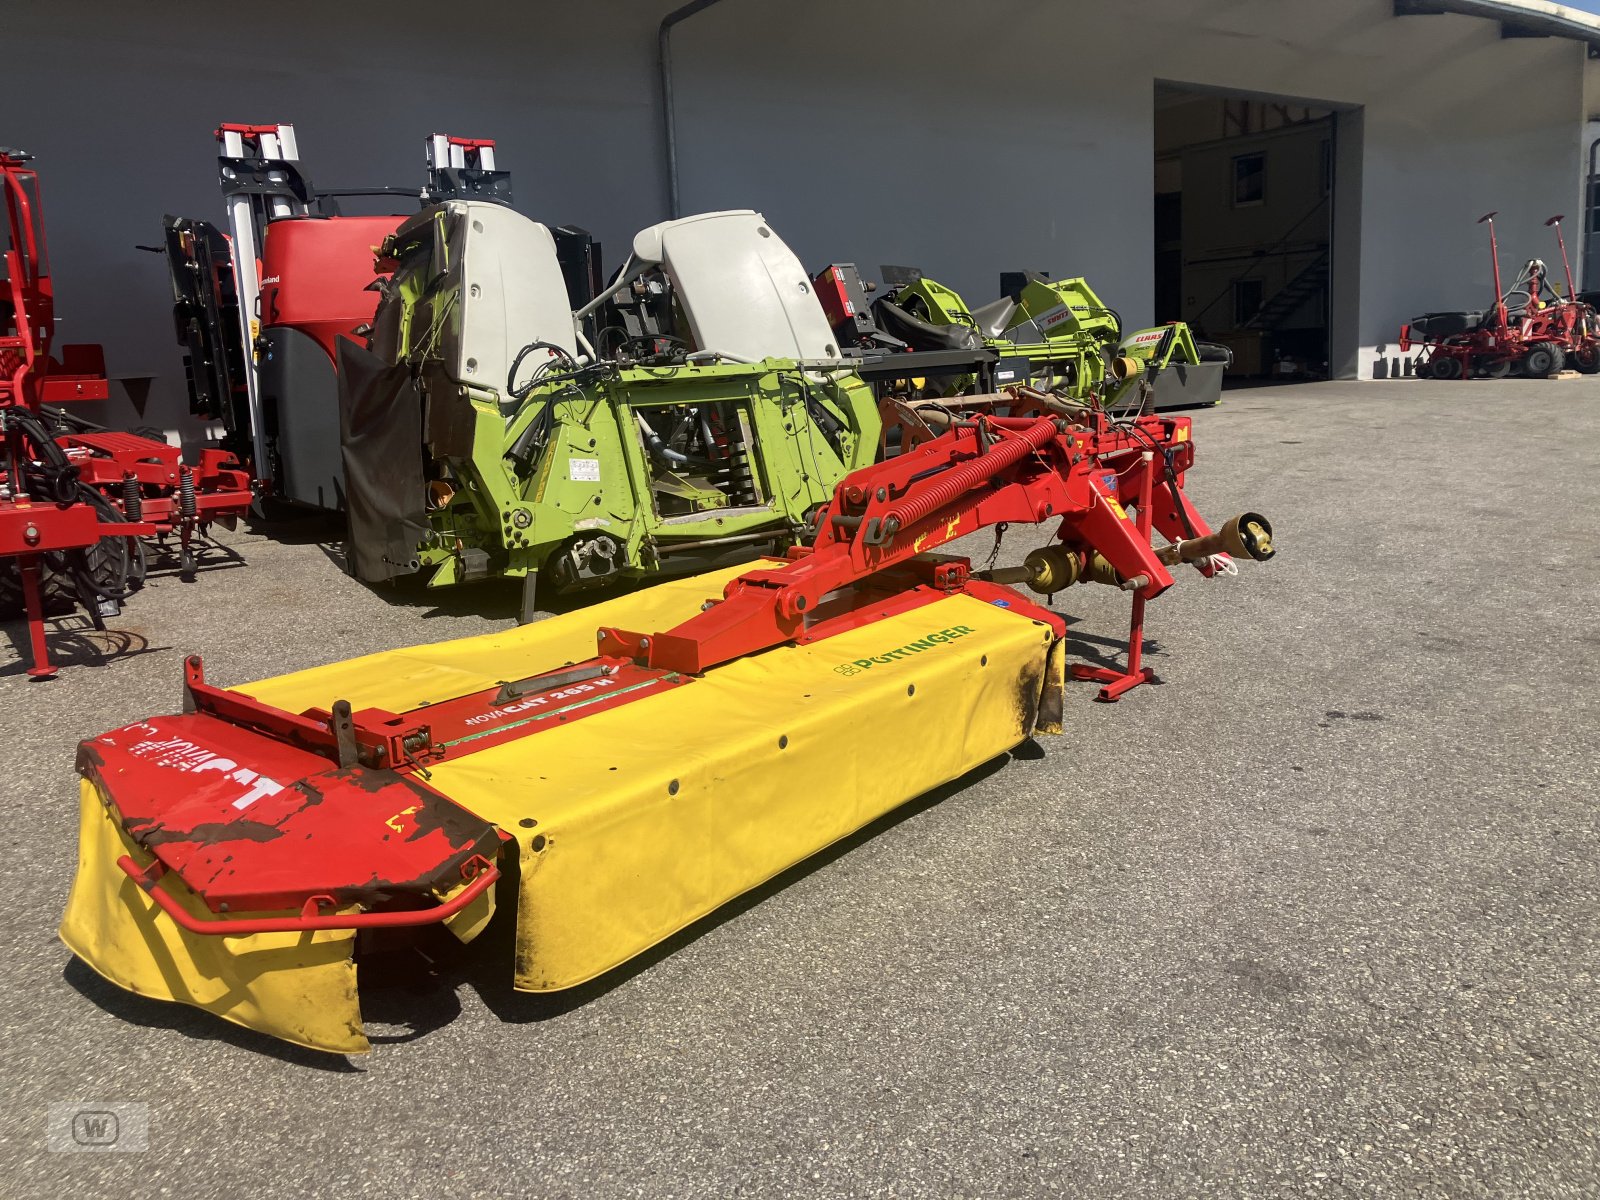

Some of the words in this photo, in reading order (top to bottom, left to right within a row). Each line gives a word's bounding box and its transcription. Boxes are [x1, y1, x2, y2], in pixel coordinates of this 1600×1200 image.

[1135, 334, 1163, 342] CLAAS
[852, 625, 976, 669] PÖTTINGER
[465, 697, 549, 726] NOVACAT
[550, 684, 595, 700] 265
[593, 678, 615, 687] H
